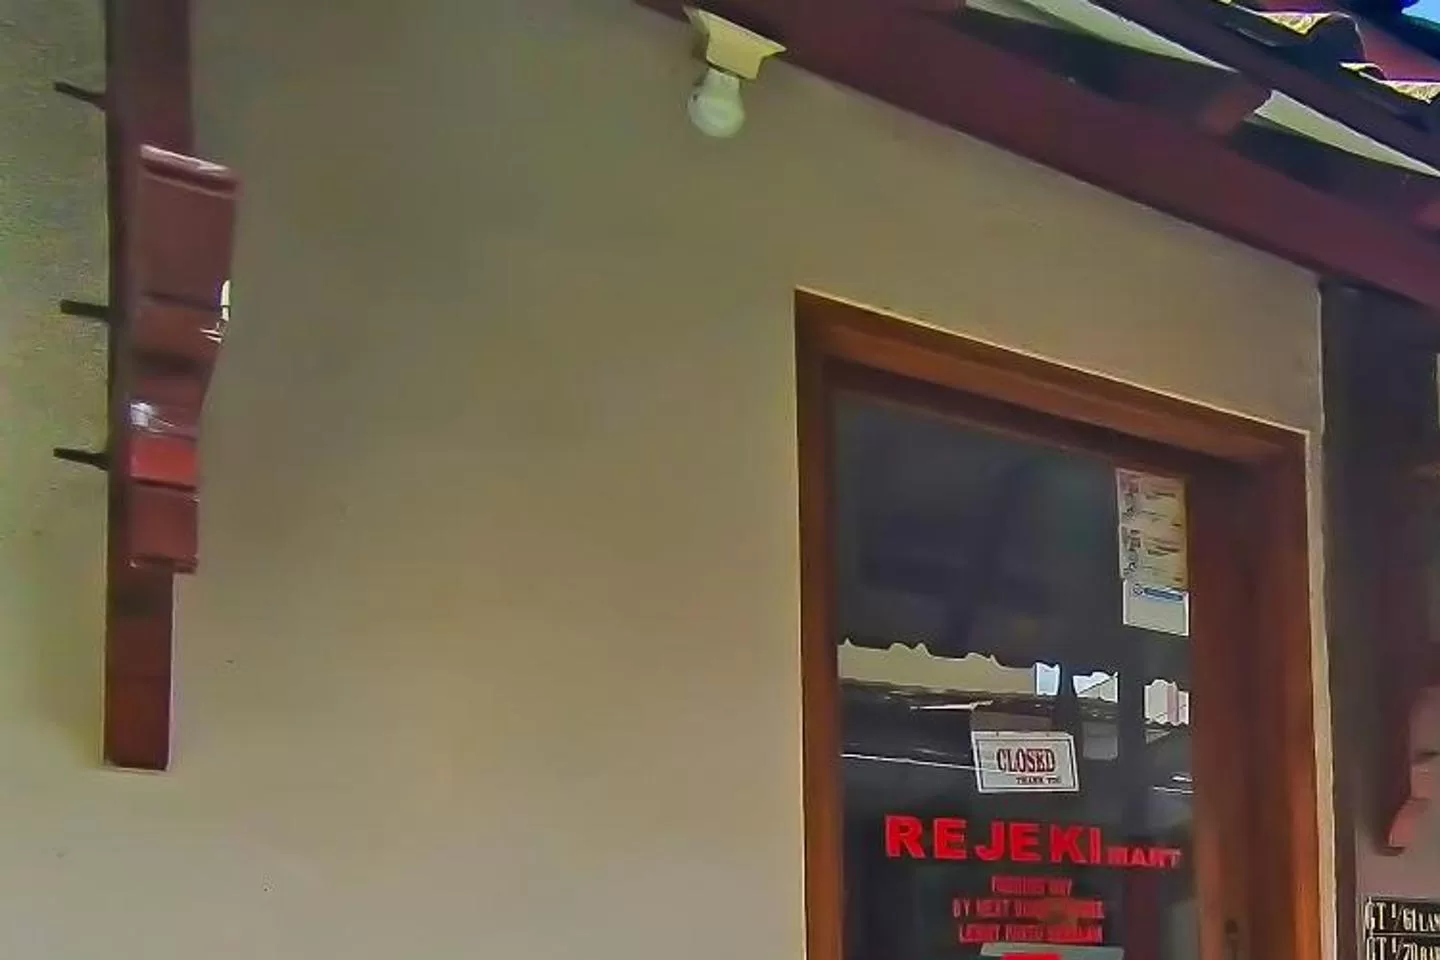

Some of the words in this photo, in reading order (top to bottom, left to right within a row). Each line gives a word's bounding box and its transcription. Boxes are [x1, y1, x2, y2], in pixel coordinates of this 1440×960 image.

[997, 748, 1055, 773] CLOSED
[885, 815, 1104, 865] REJEKI
[1106, 845, 1184, 870] MART
